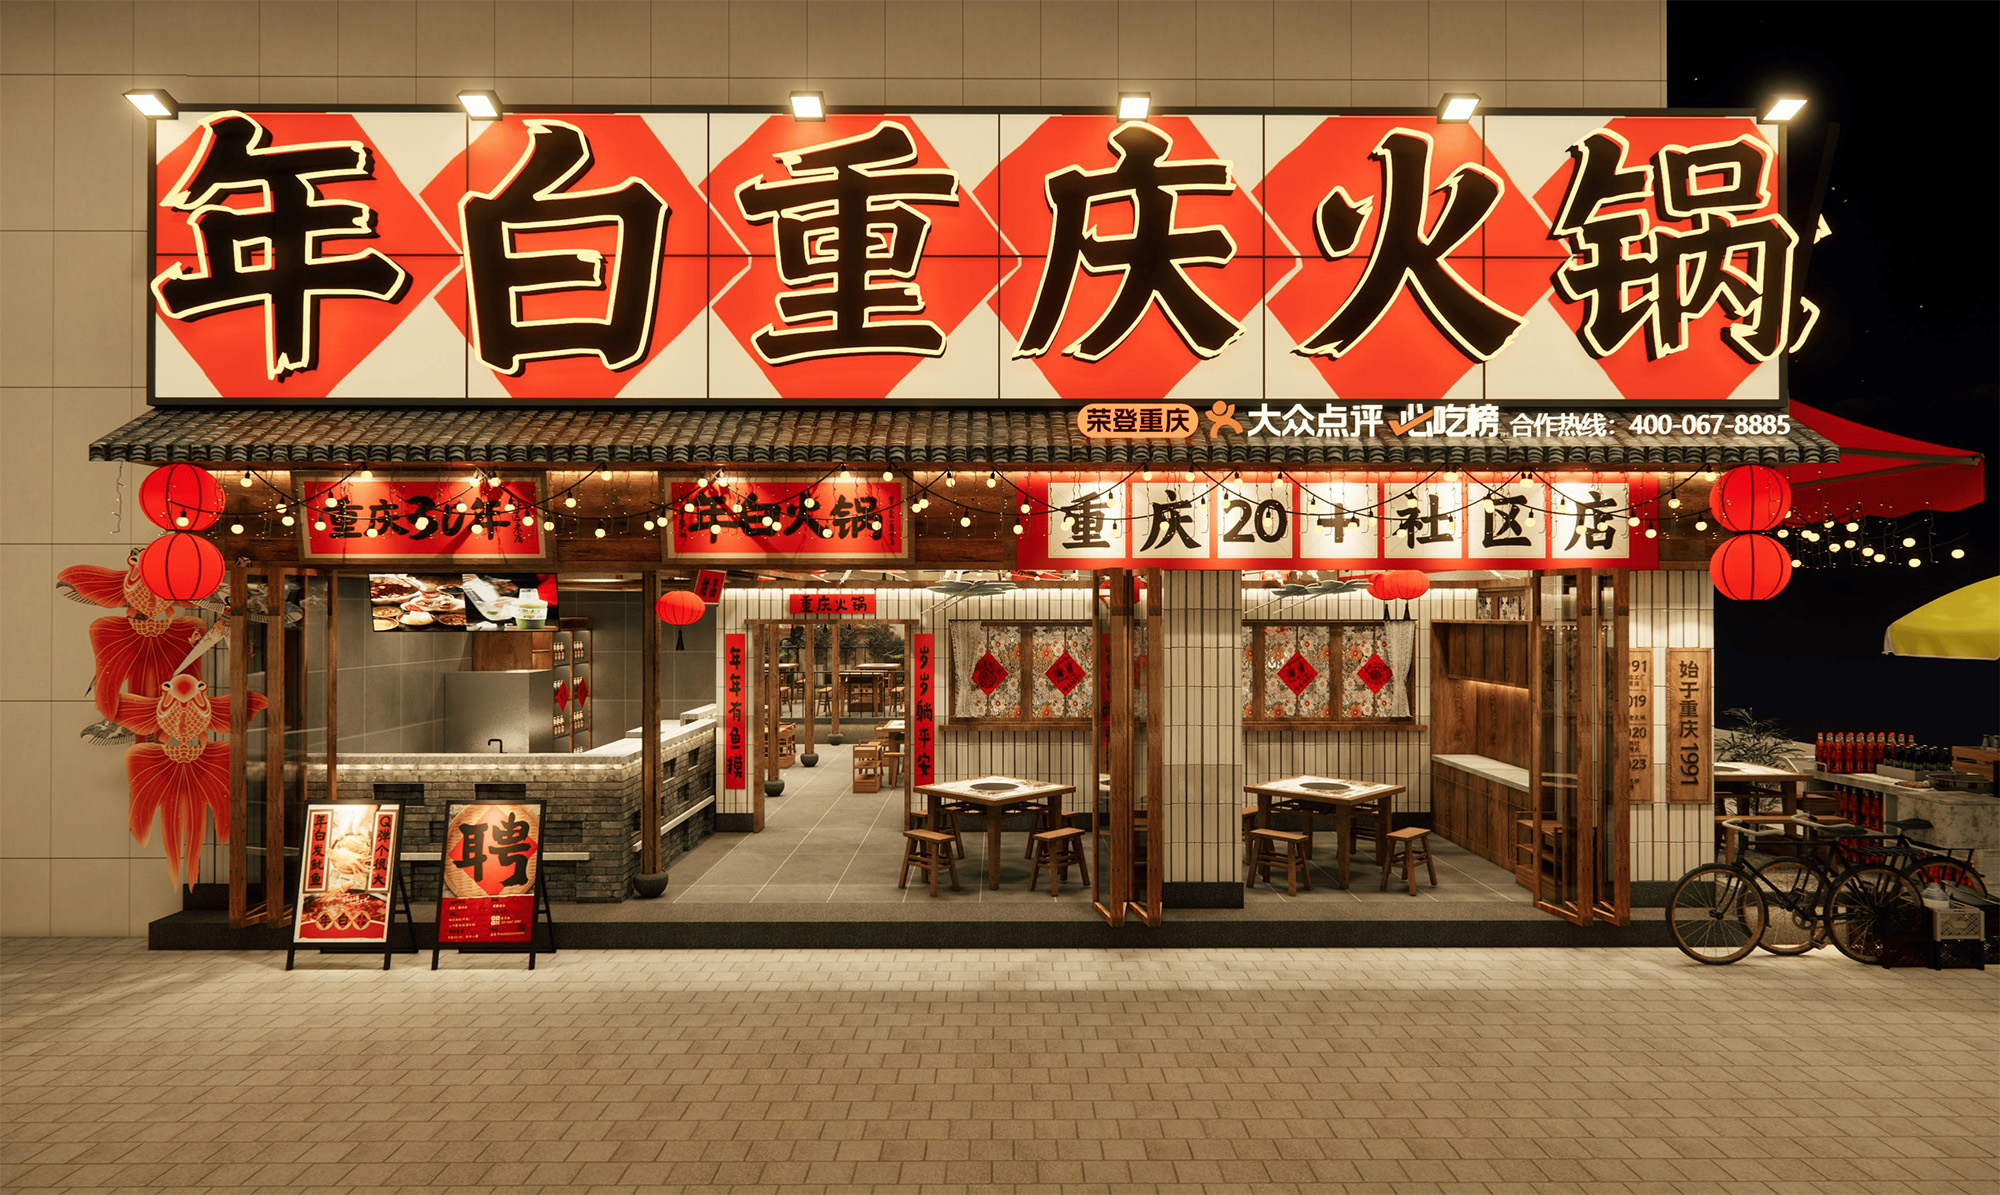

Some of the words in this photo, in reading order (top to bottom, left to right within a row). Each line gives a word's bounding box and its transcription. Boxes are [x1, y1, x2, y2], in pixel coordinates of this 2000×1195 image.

[151, 110, 1801, 380] 年白重庆火锅
[1086, 407, 1190, 433] 荣登重庆
[1247, 403, 1383, 438] 大众点评
[1389, 403, 1499, 438] 必吃榜
[1628, 414, 1791, 436] 400-067-8885
[800, 595, 867, 613] 重庆火锅
[916, 646, 933, 777] 岁岁躺平安
[1678, 660, 1700, 739] 始于重庆
[1680, 743, 1700, 786] 1991
[372, 815, 392, 886] Q弹个很大
[453, 812, 532, 887] 聘
